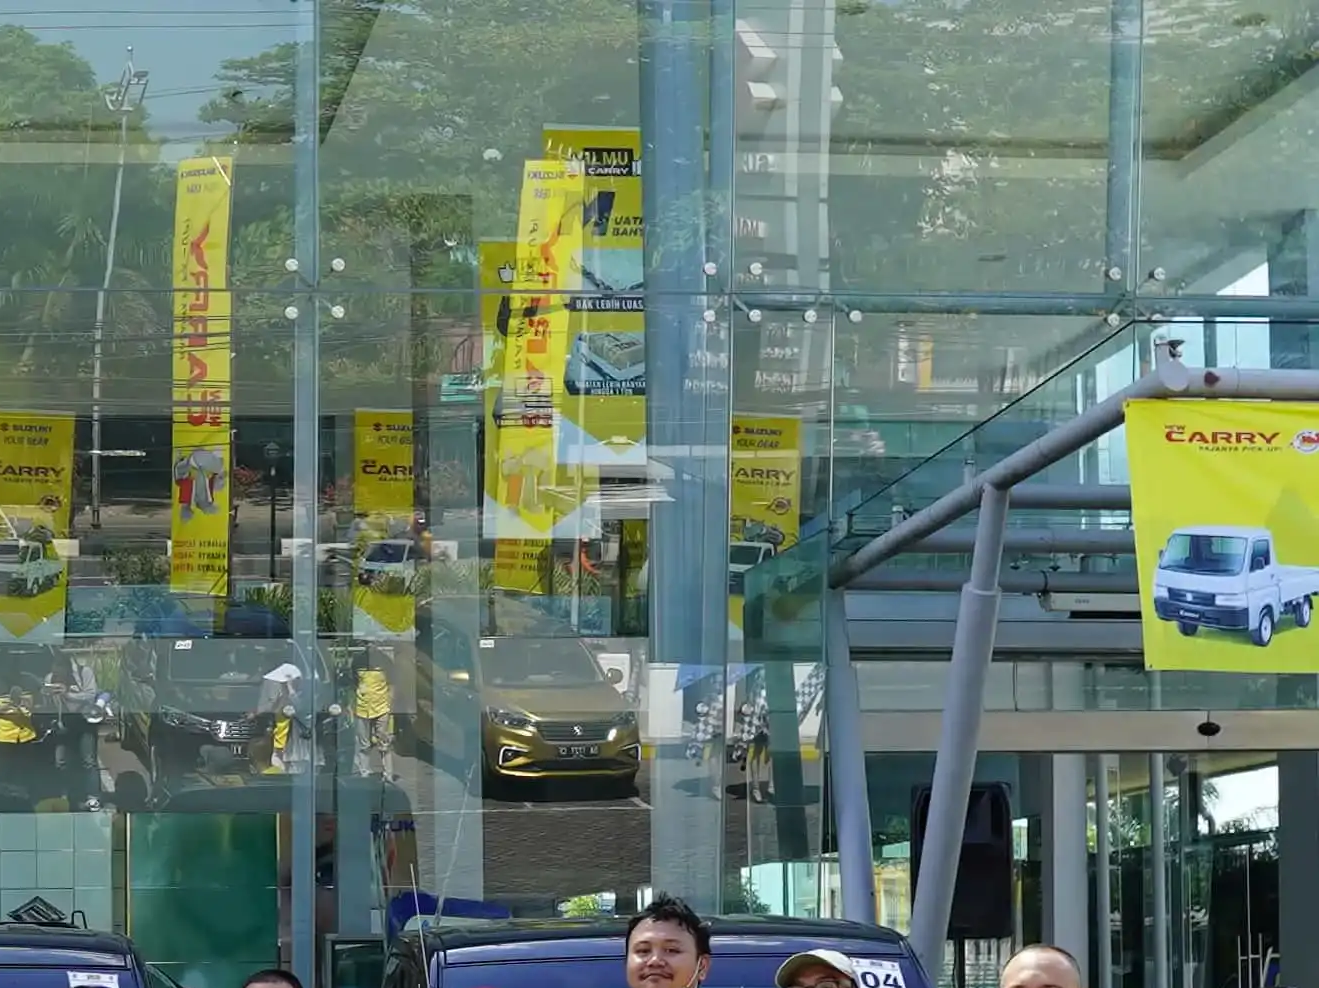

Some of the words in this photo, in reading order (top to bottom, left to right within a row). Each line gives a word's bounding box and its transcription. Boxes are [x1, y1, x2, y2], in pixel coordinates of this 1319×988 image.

[588, 166, 630, 175] CARRY
[1165, 431, 1281, 444] CARRY
[362, 465, 414, 475] CAR
[734, 467, 796, 481] ARRY
